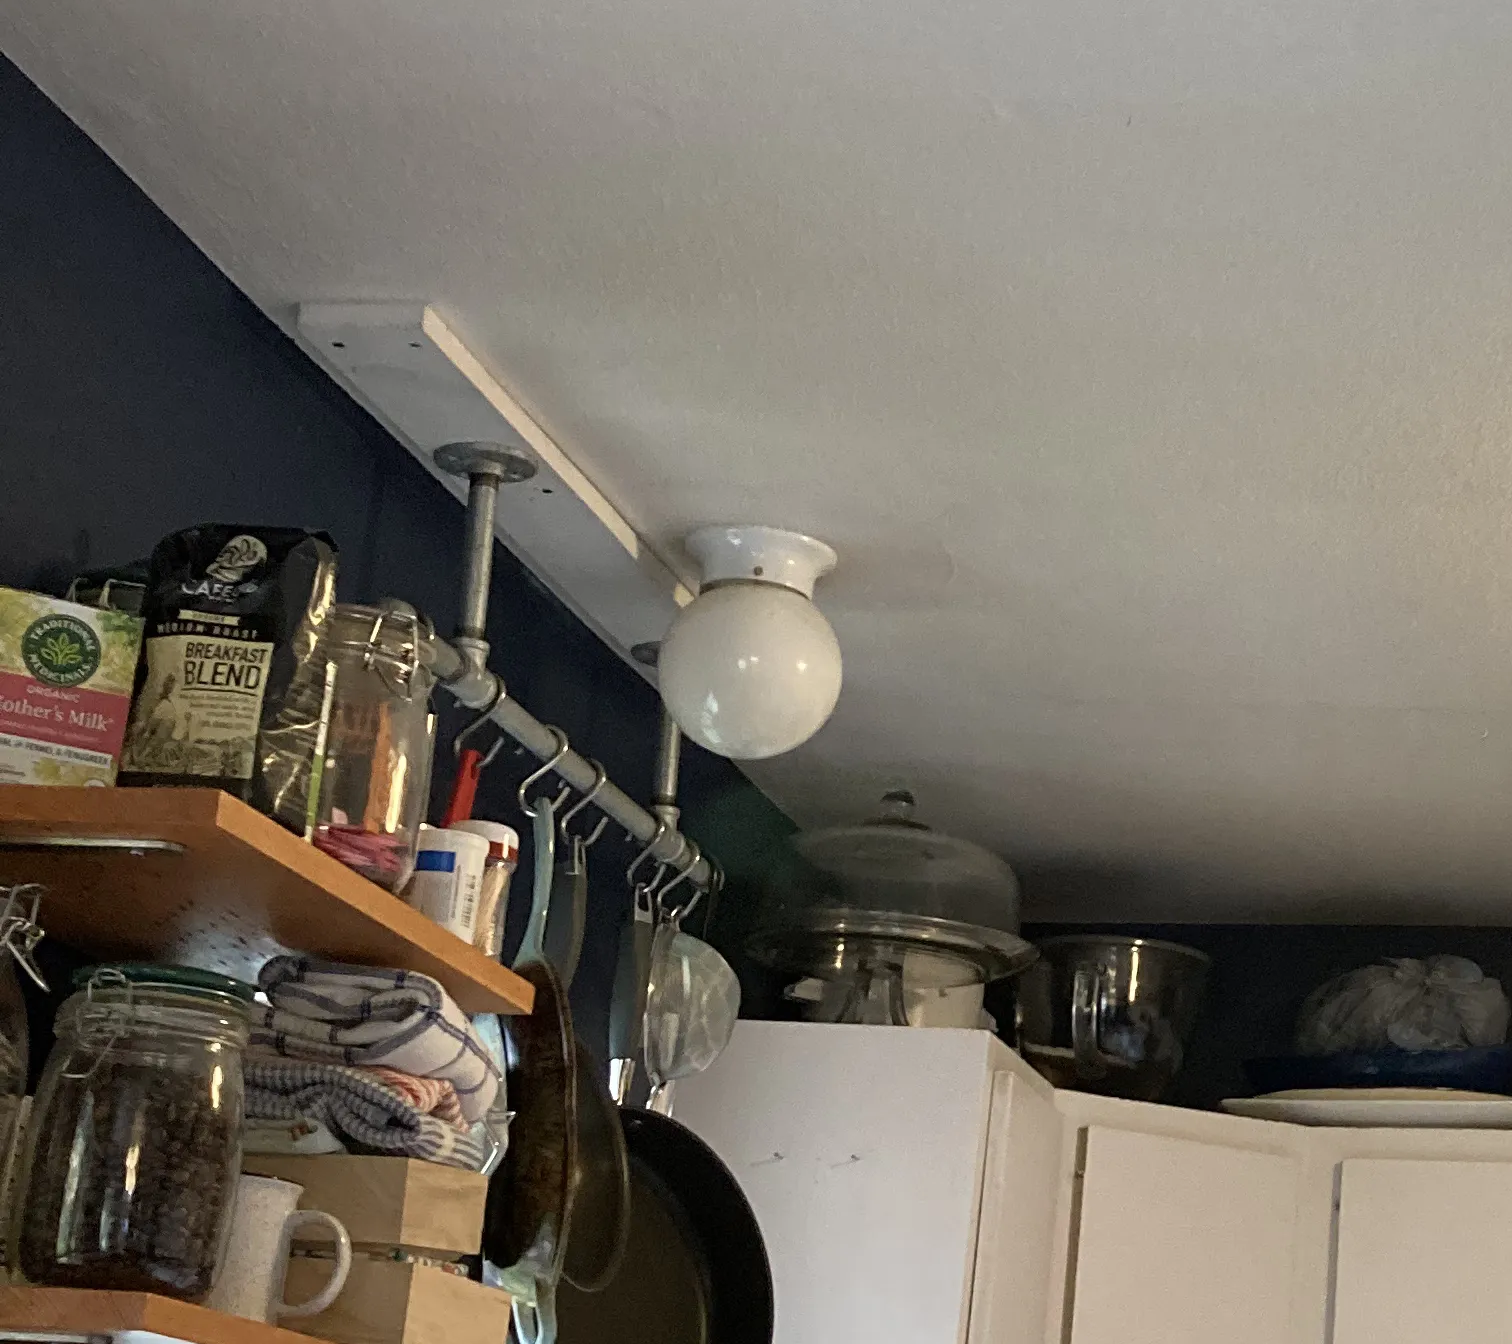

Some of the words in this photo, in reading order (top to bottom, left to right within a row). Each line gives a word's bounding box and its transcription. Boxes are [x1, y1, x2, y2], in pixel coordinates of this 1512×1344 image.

[30, 619, 96, 651] TRADITIONAL
[185, 641, 267, 664] BREAKFAST
[28, 653, 92, 684] MEDICINALS
[183, 660, 261, 690] BLEND
[26, 684, 81, 704] ORGANIC
[0, 694, 64, 723] other's
[69, 709, 108, 733] Milk
